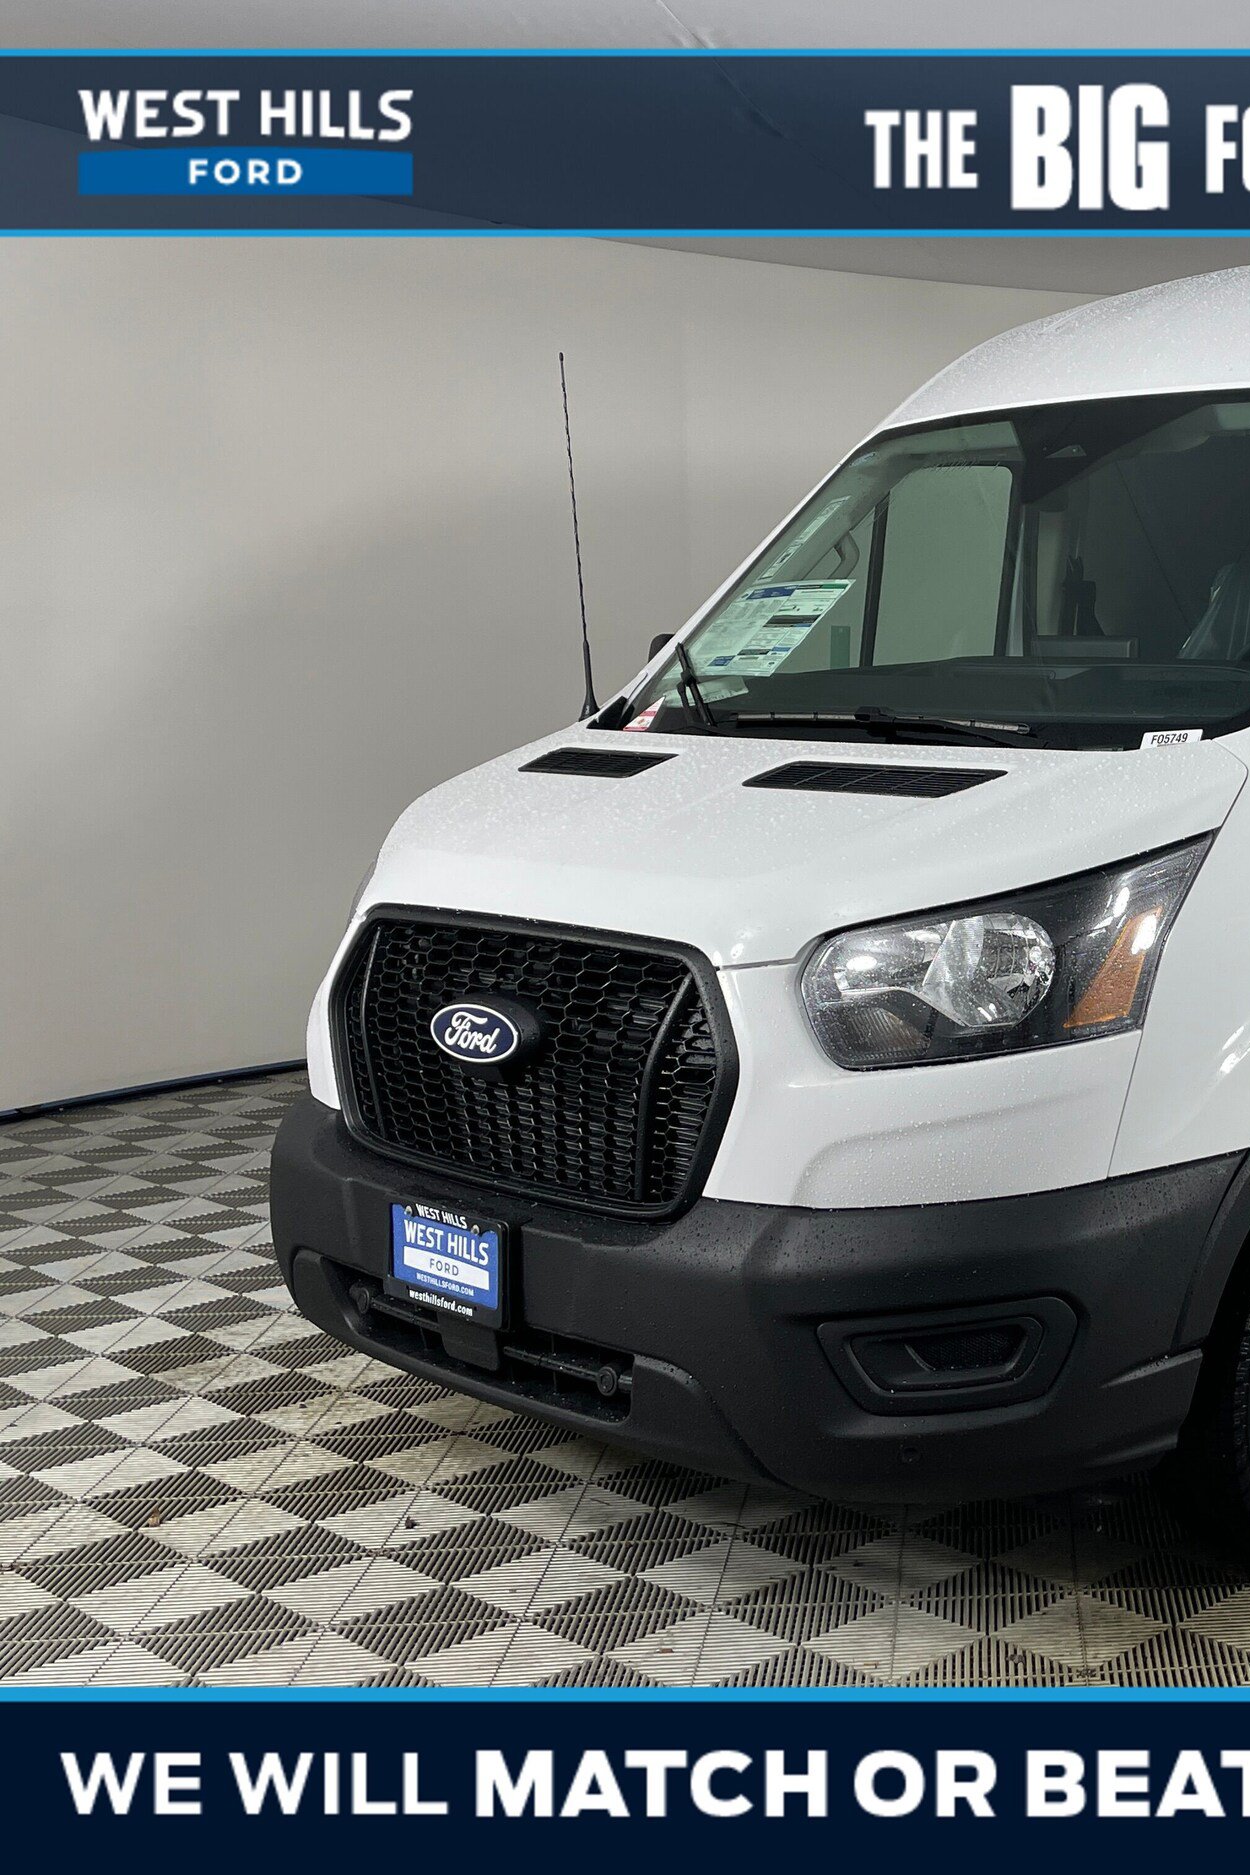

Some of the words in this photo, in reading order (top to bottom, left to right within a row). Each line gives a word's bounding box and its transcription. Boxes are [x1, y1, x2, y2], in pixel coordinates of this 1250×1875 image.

[444, 1011, 501, 1054] Ford
[415, 1203, 441, 1222] WEST
[442, 1210, 468, 1230] HILLS
[404, 1219, 445, 1251] WEST
[447, 1232, 490, 1266] HILLS
[428, 1258, 460, 1277] FORD
[416, 1272, 475, 1297] WESTHILLSFORD.COM
[409, 1289, 473, 1317] westhillsford.com
